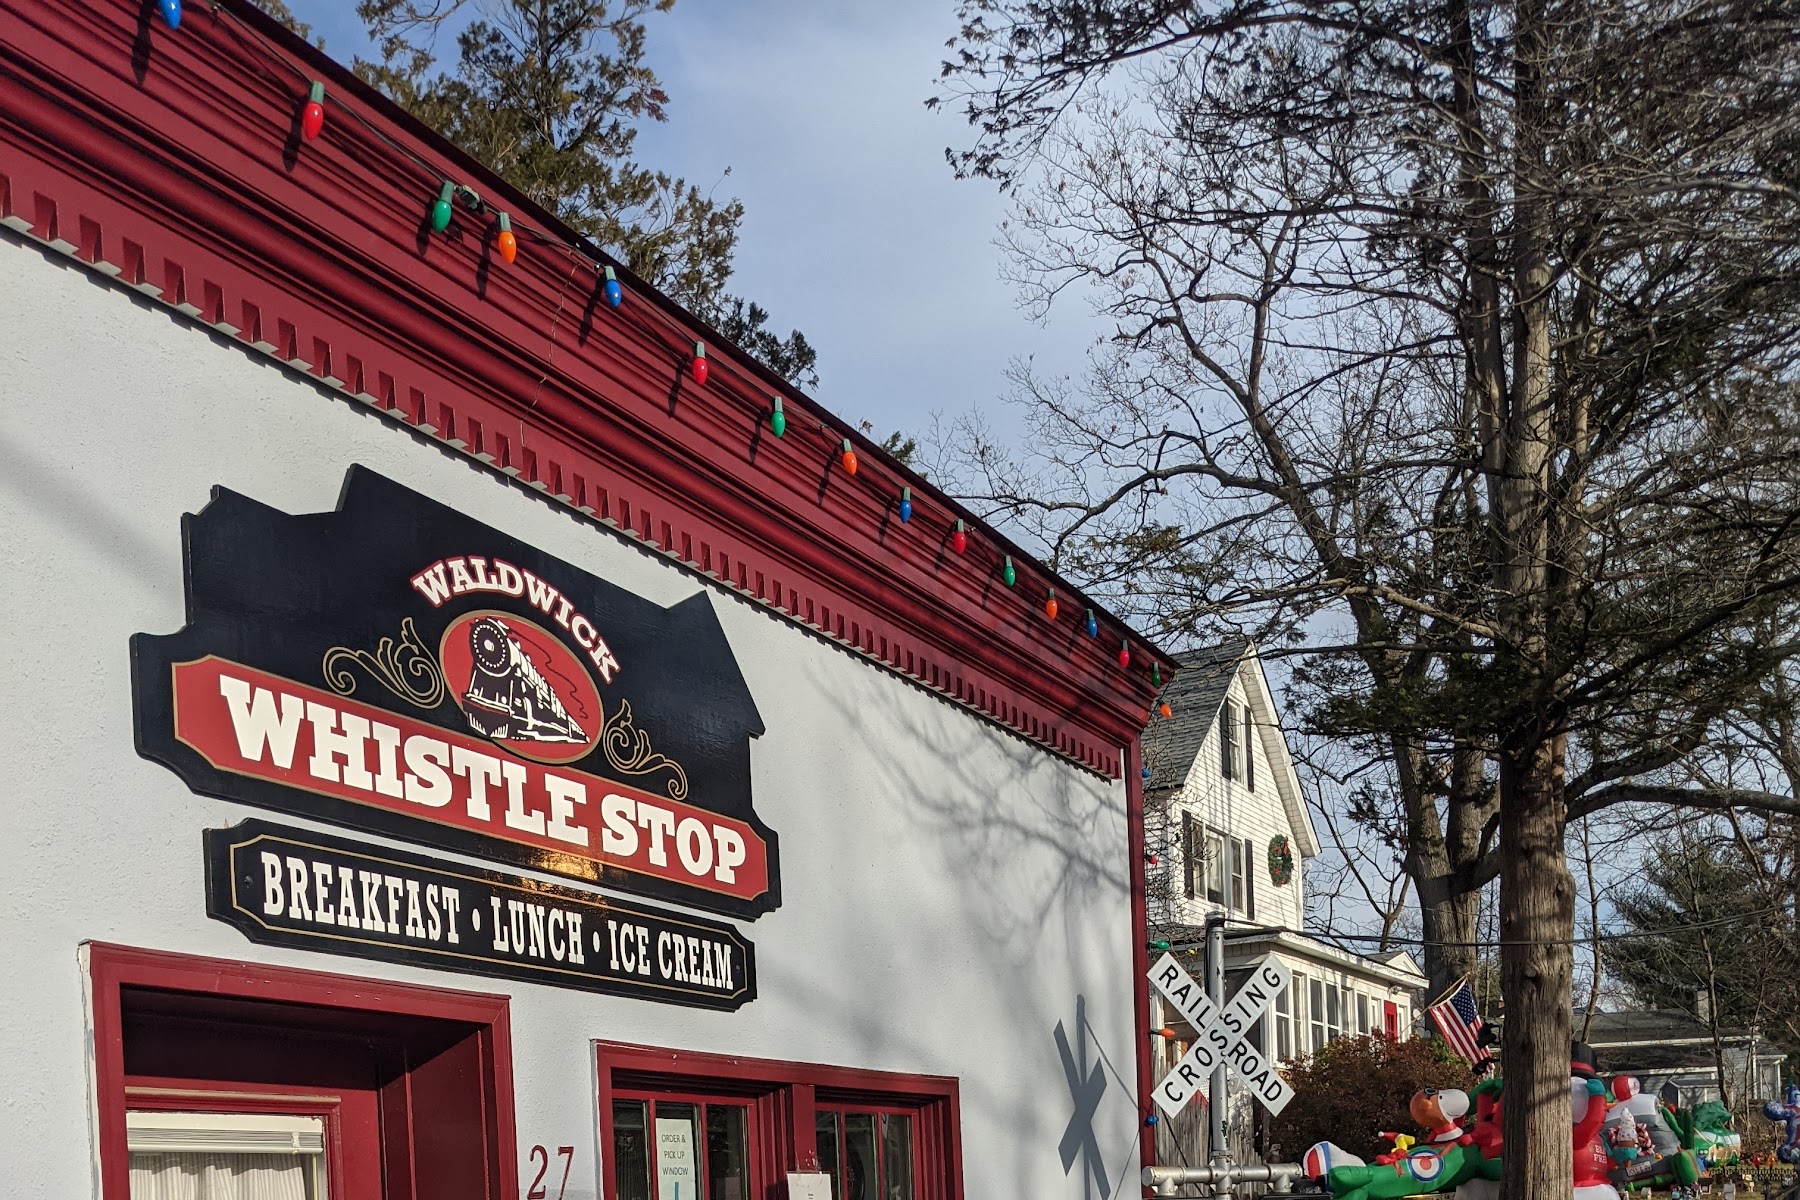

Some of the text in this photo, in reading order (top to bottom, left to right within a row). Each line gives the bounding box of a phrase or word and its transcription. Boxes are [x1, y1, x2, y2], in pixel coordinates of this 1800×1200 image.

[410, 557, 622, 685] WALDWICK
[220, 673, 746, 885] WHISTLE STOP
[261, 851, 734, 991] BREAKFAST LUNCH ICE CREAM
[1164, 967, 1281, 1103] CROSSING
[527, 1145, 574, 1200] 27
[661, 1134, 686, 1143] ORDER &
[662, 1167, 688, 1175] WINDOW
[664, 1150, 685, 1159] PICK UP
